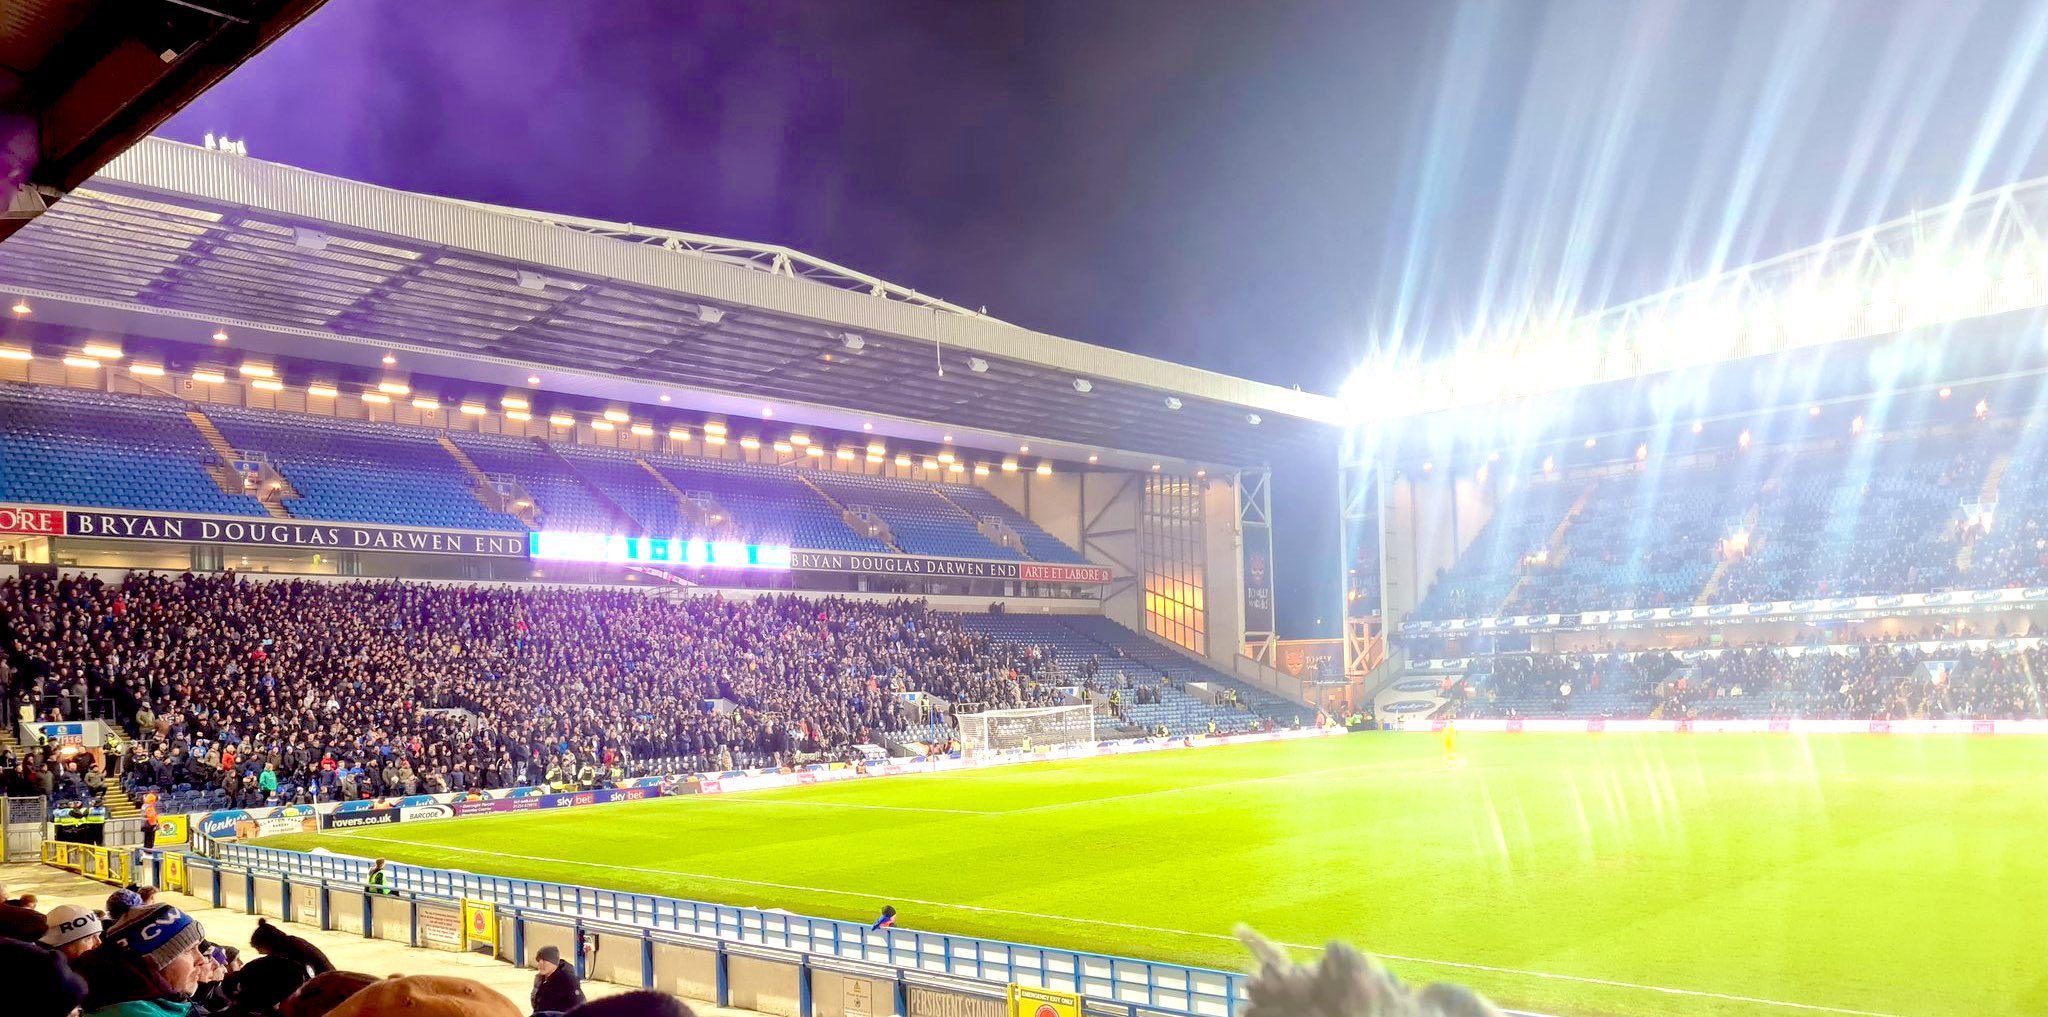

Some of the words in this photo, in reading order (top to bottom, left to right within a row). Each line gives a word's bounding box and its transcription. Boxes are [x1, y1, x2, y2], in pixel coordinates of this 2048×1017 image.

[78, 515, 183, 537] BRYAN
[202, 522, 340, 545] DOUGLAS
[354, 530, 461, 550] DARWEN
[476, 537, 522, 553] END
[791, 553, 843, 568] BRYAN
[851, 557, 920, 573] DOUGLAS
[927, 561, 984, 575] DARWEN
[991, 564, 1016, 577] END
[1025, 566, 1049, 578] ARTE
[1052, 568, 1062, 579] ET
[1065, 568, 1099, 580] LABORE
[557, 797, 573, 807] sky
[576, 795, 592, 805] bet
[610, 792, 625, 802] sky
[628, 791, 643, 800] bet
[332, 813, 392, 828] rovers.co.uk
[409, 811, 440, 819] BARCODE
[911, 988, 963, 1017] PERSISTENT
[965, 998, 1008, 1017] STANDIN
[1021, 990, 1049, 1001] EMERGENCY
[1061, 998, 1073, 1006] ONLY
